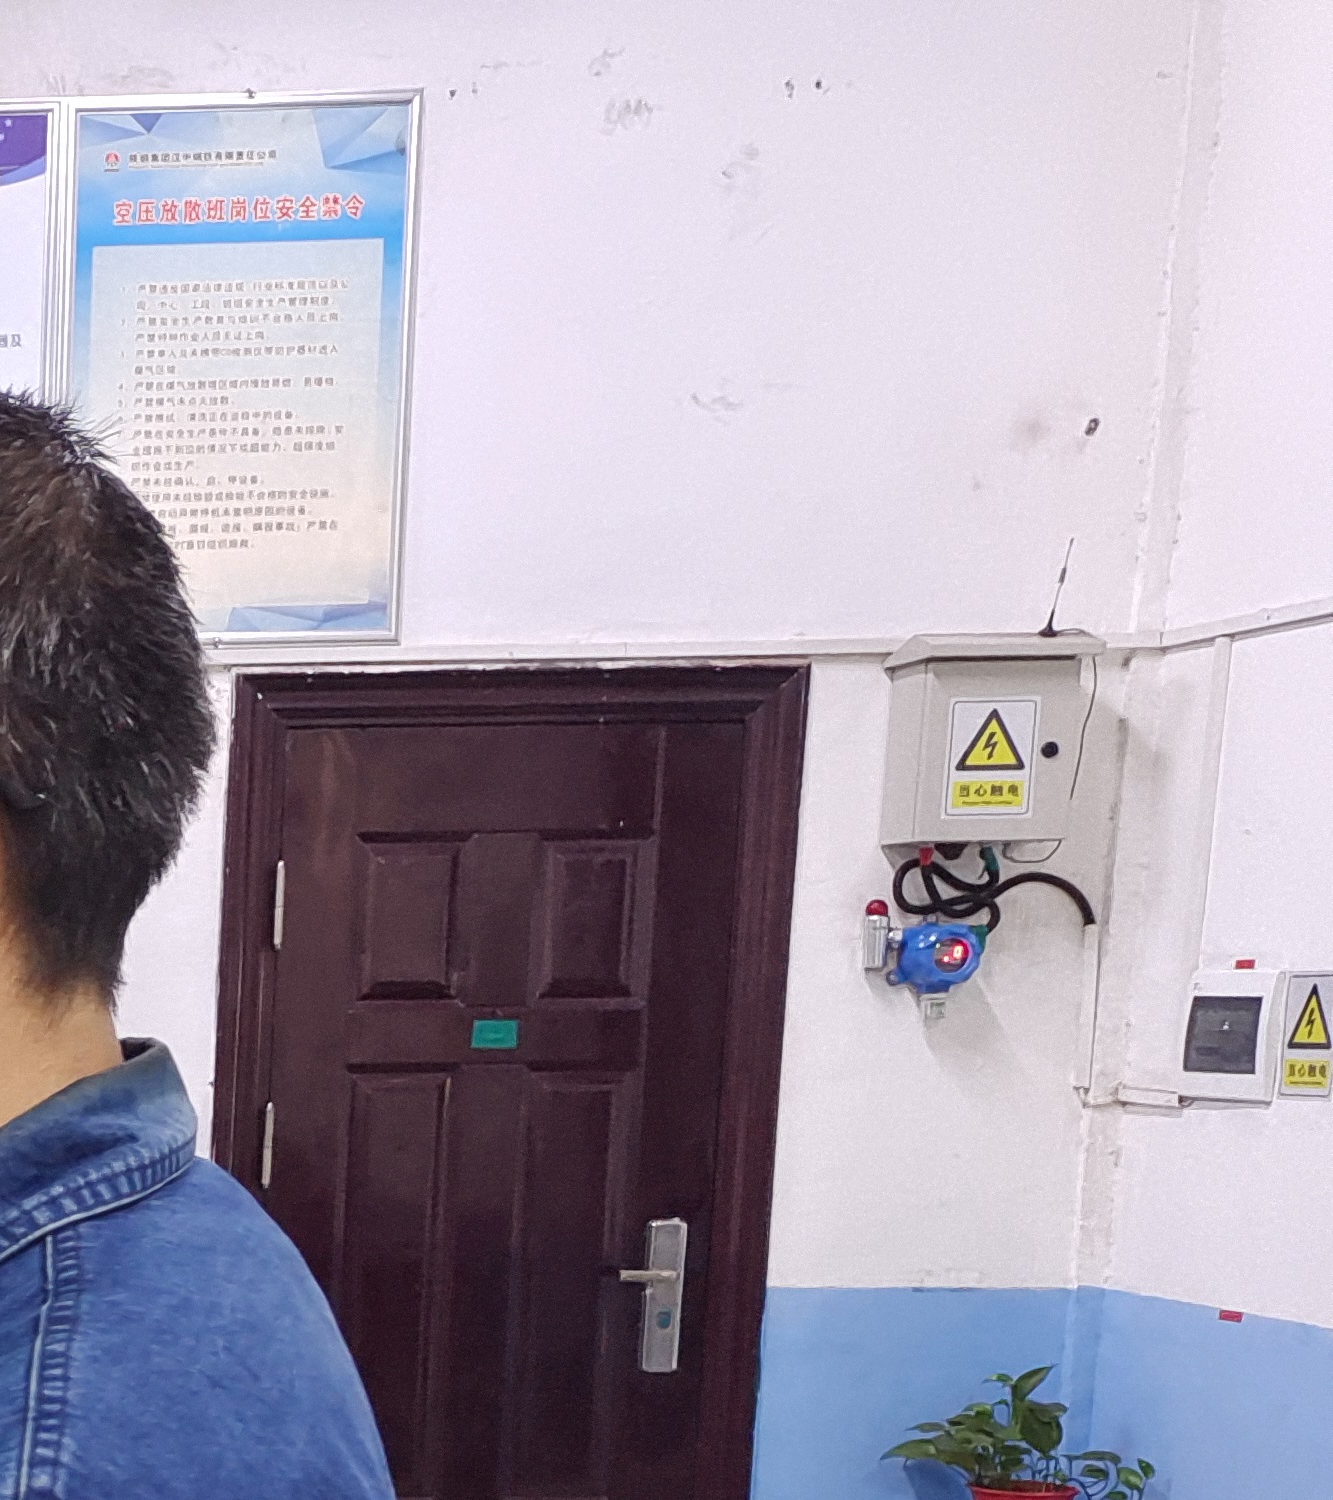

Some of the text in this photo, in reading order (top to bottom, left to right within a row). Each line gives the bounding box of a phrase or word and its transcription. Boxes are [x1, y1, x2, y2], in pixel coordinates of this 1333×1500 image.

[114, 194, 365, 225] 空压放散班岗位安全禁令
